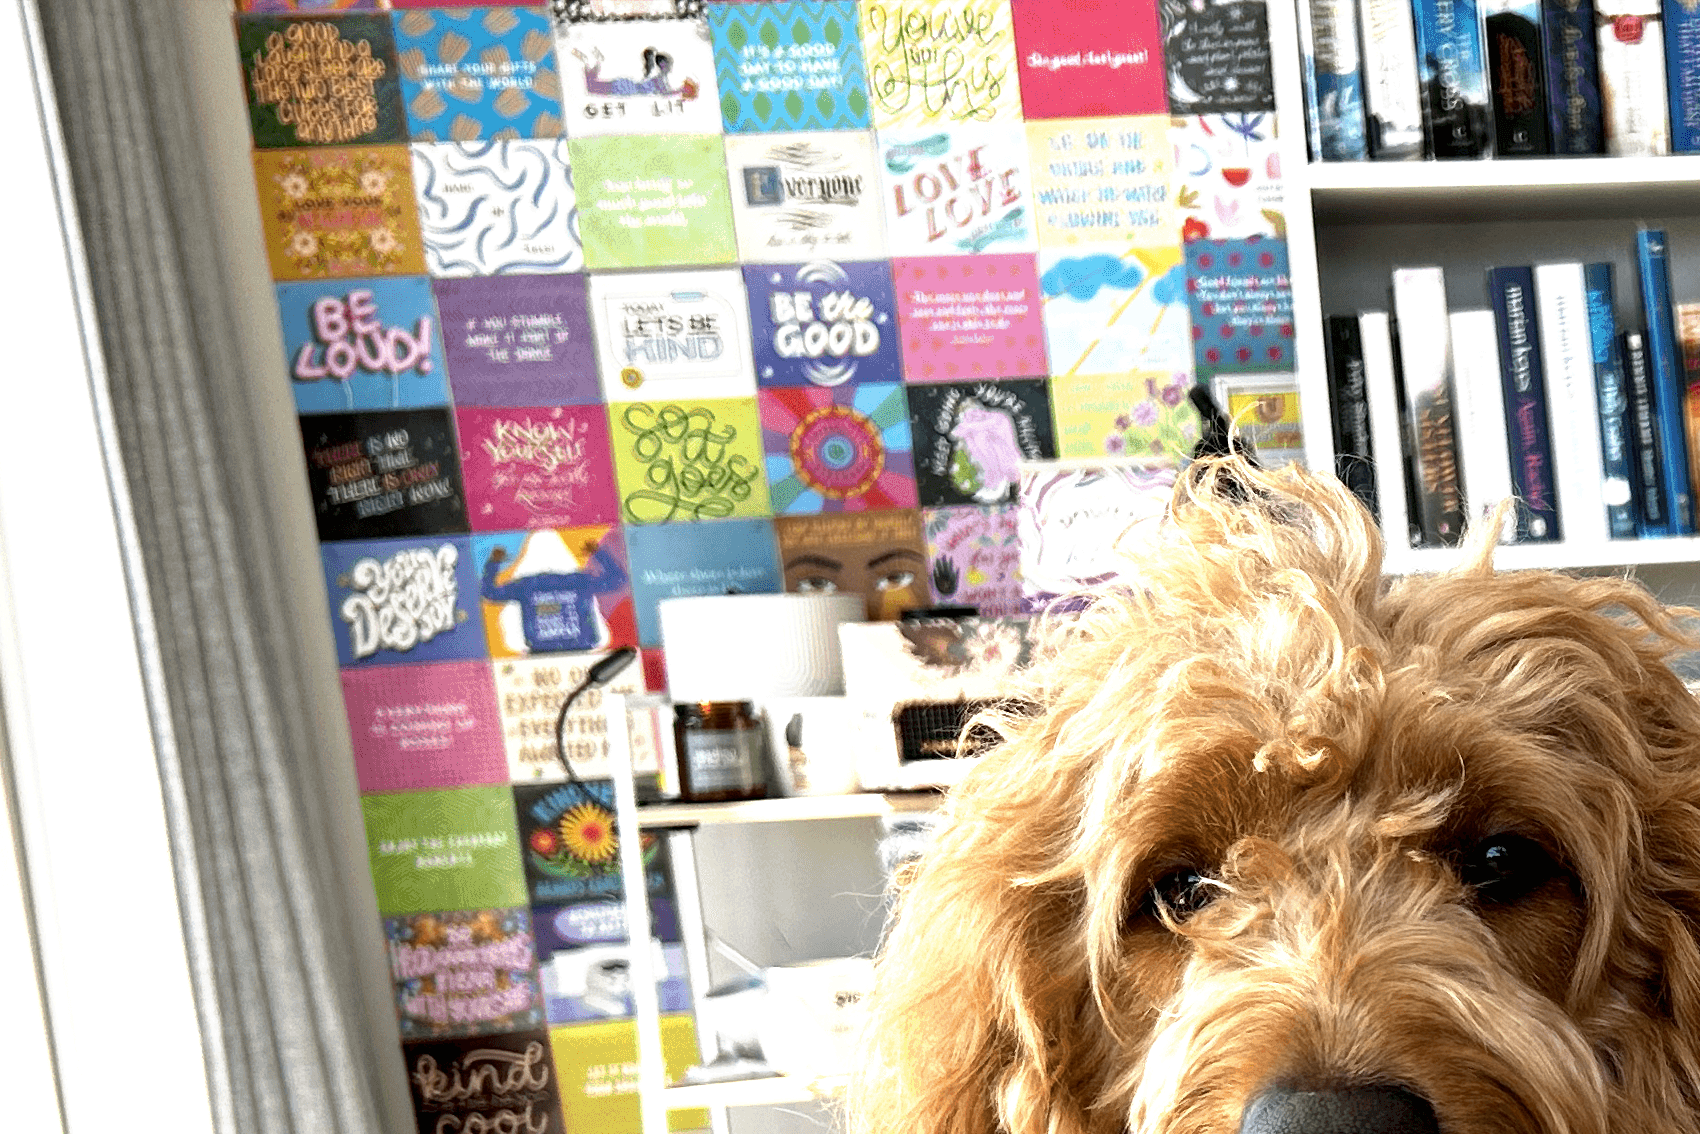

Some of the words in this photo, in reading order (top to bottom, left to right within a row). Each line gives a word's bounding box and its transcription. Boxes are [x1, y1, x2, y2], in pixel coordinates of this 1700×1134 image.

[893, 145, 986, 217] LOVE
[926, 168, 1022, 243] LOVE
[315, 289, 379, 343] BE
[772, 291, 814, 324] BE
[1505, 284, 1532, 348] marian
[294, 315, 433, 379] LOUD!
[623, 336, 725, 364] KIND
[774, 319, 882, 358] GOOD
[412, 1041, 548, 1100] kind
